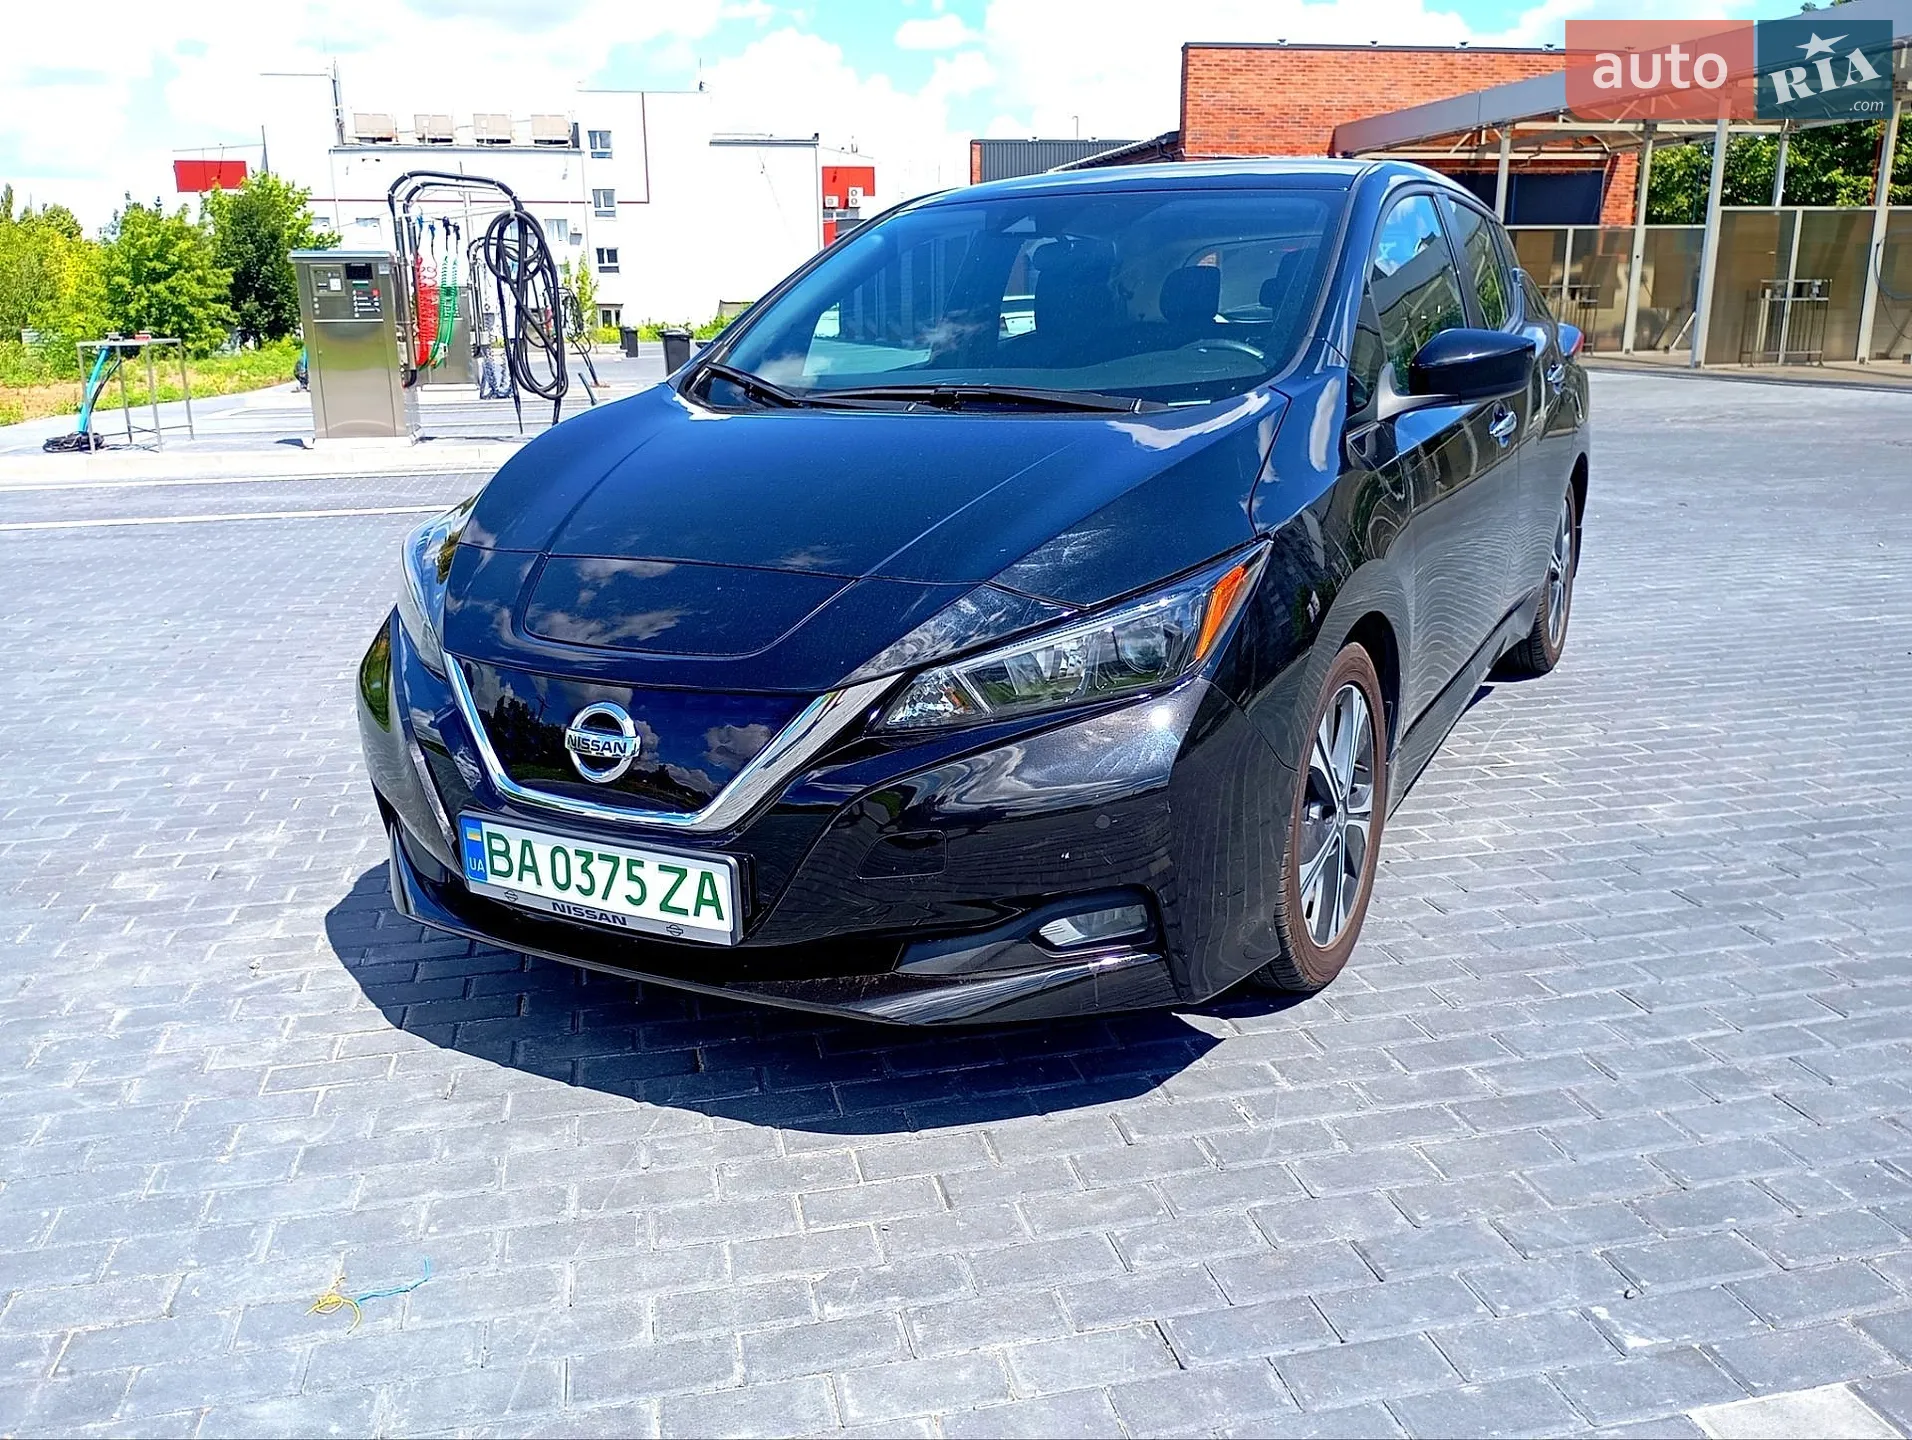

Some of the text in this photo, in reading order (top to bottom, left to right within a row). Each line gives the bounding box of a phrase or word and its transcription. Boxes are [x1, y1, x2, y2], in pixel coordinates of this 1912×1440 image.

[567, 734, 627, 754] NISSAN
[469, 857, 485, 873] UA
[486, 831, 724, 921] BA 0375 ZA
[552, 901, 628, 926] NISSAN
